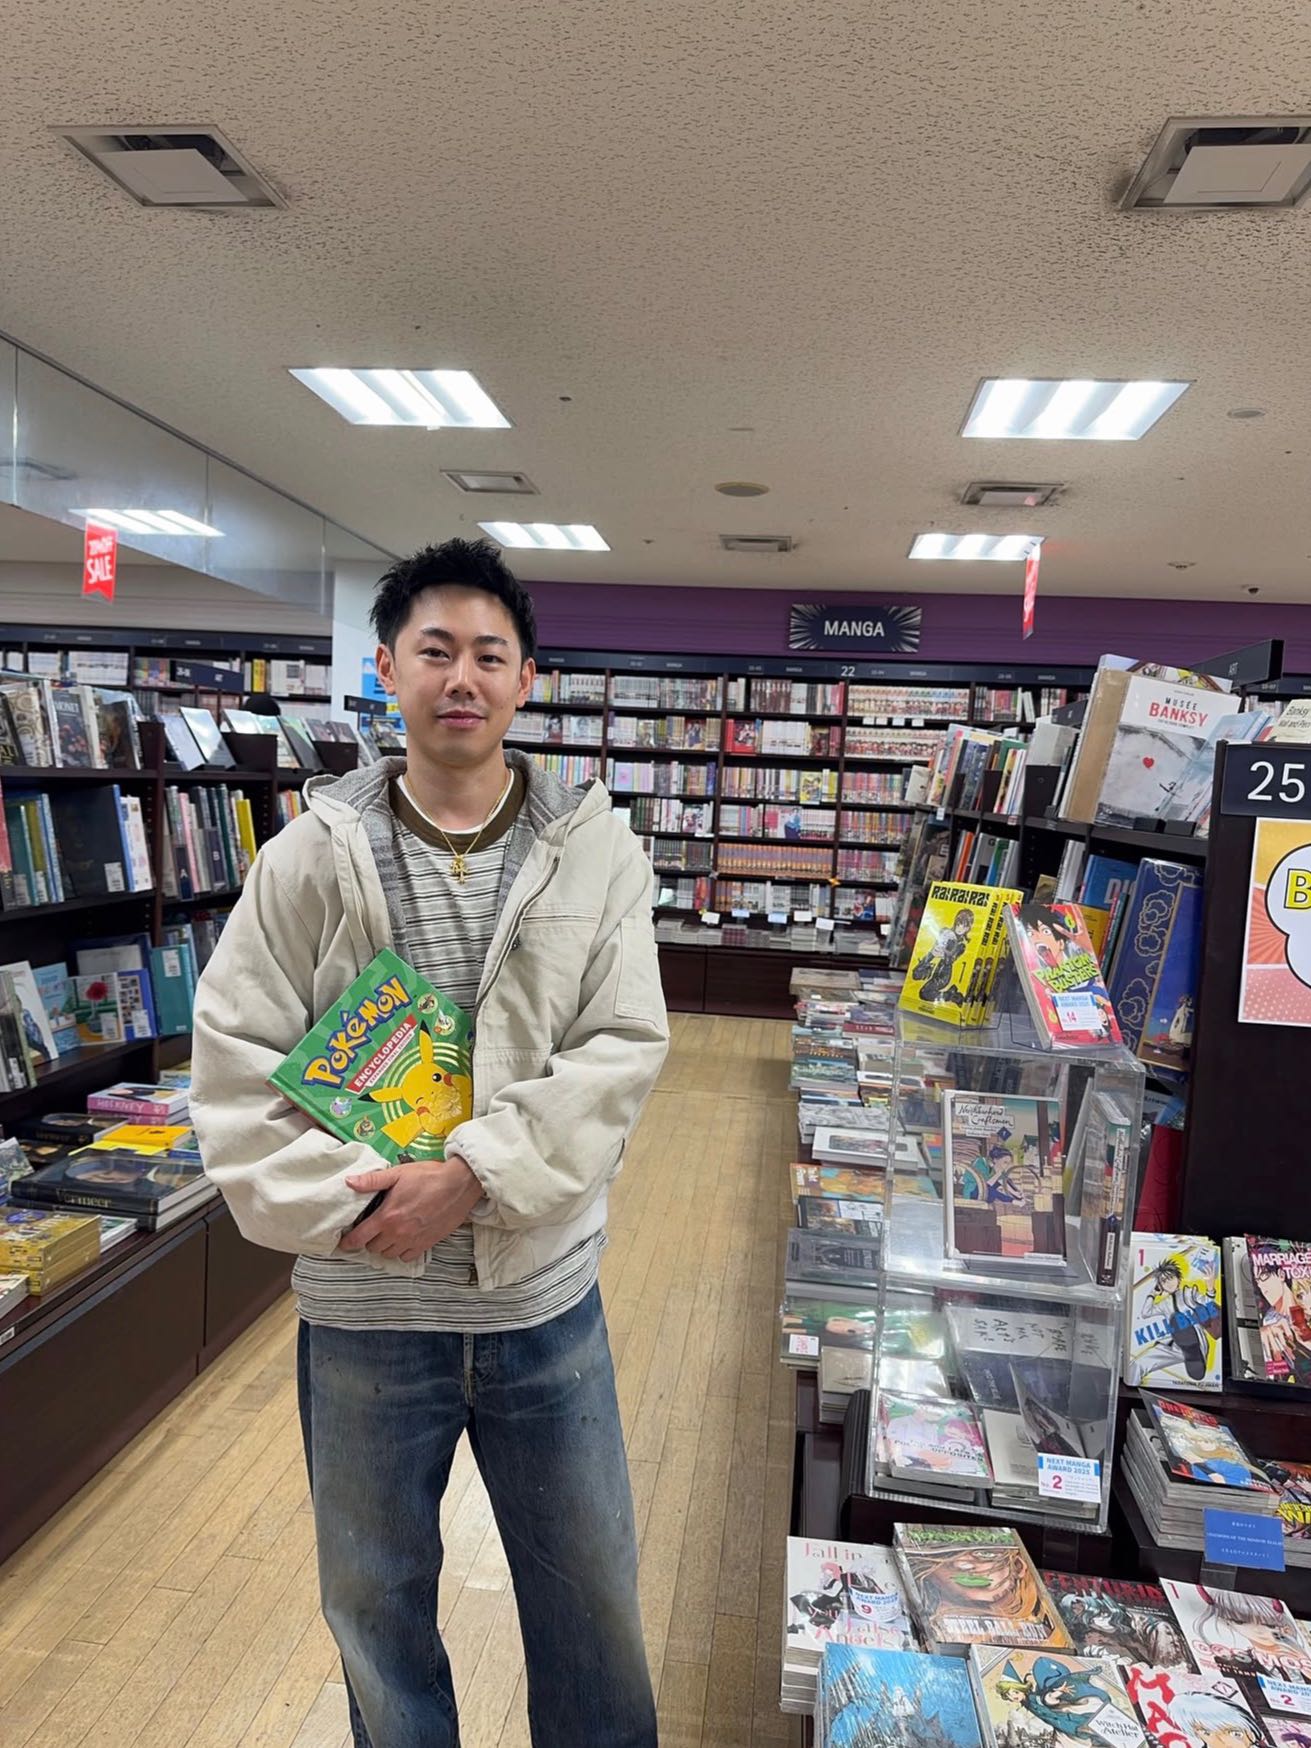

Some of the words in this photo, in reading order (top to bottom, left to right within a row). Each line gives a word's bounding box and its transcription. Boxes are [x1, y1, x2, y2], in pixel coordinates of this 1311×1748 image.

[86, 555, 113, 584] SALE
[824, 620, 885, 637] MANGA
[840, 665, 856, 678] 22
[1149, 701, 1208, 728] BANKSY
[1247, 761, 1305, 802] 25
[354, 1023, 411, 1087] ENCYCLOPEDIA
[56, 1187, 111, 1208] Vermeer
[1138, 1249, 1145, 1267] 1
[1252, 1250, 1311, 1266] MARRIAGE
[1135, 1318, 1174, 1346] KILL
[1046, 1457, 1065, 1465] NEXT
[1066, 1459, 1091, 1468] MANGA
[1048, 1465, 1073, 1473] AWARD
[1052, 1474, 1063, 1490] 2
[861, 1604, 872, 1615] 9
[1280, 1694, 1296, 1706] 2
